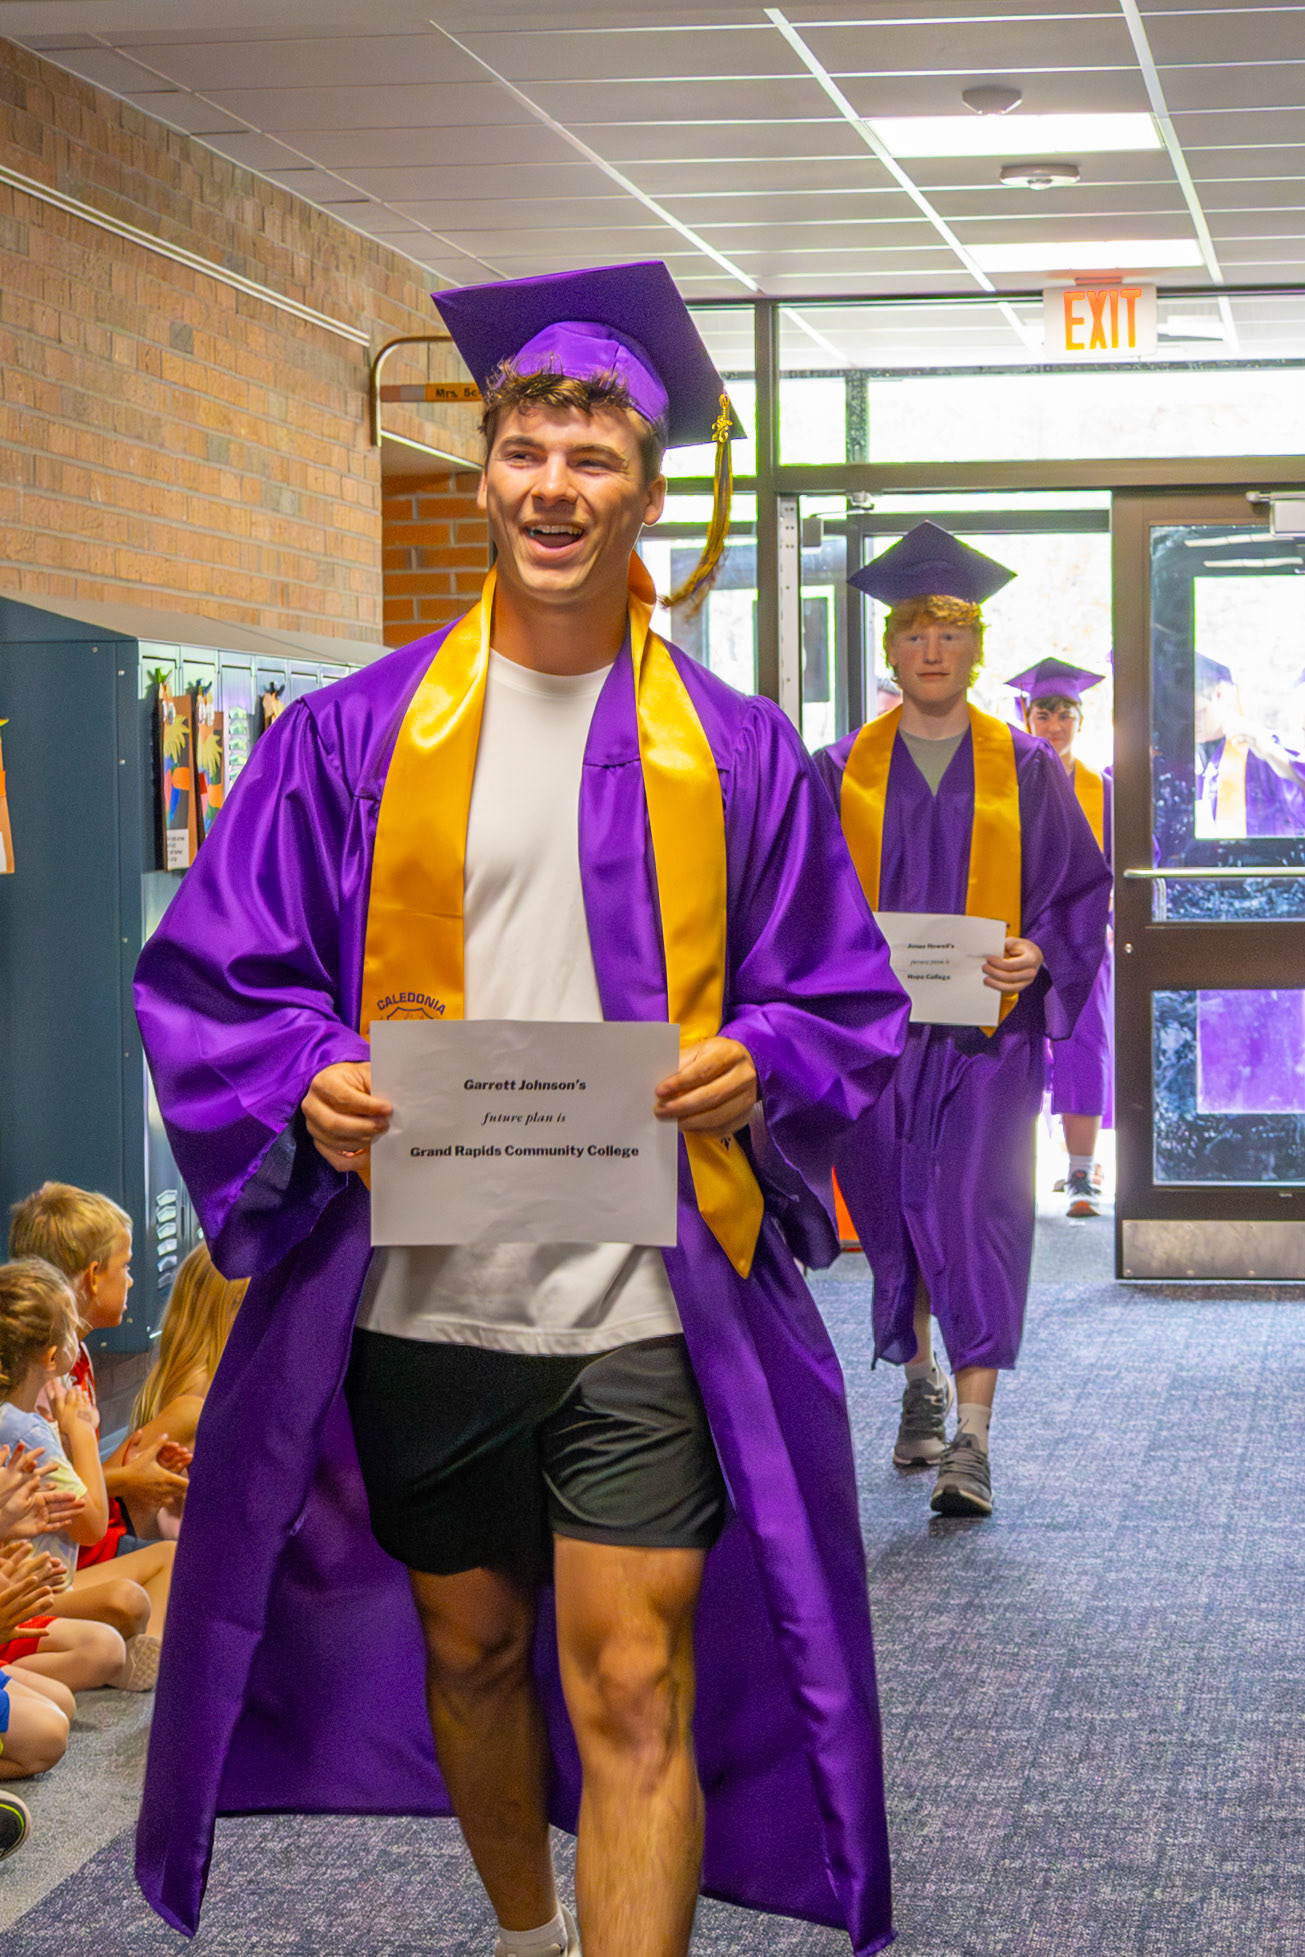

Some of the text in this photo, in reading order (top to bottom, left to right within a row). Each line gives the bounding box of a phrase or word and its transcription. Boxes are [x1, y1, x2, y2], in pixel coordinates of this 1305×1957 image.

[1063, 288, 1142, 351] EXIT
[435, 387, 480, 398] Mrs. Sc
[377, 992, 446, 1015] CALEDONIA
[463, 1079, 586, 1091] Garrett Johnson's
[481, 1111, 567, 1126] future plan is
[410, 1144, 639, 1158] Grand Rapids Community College
